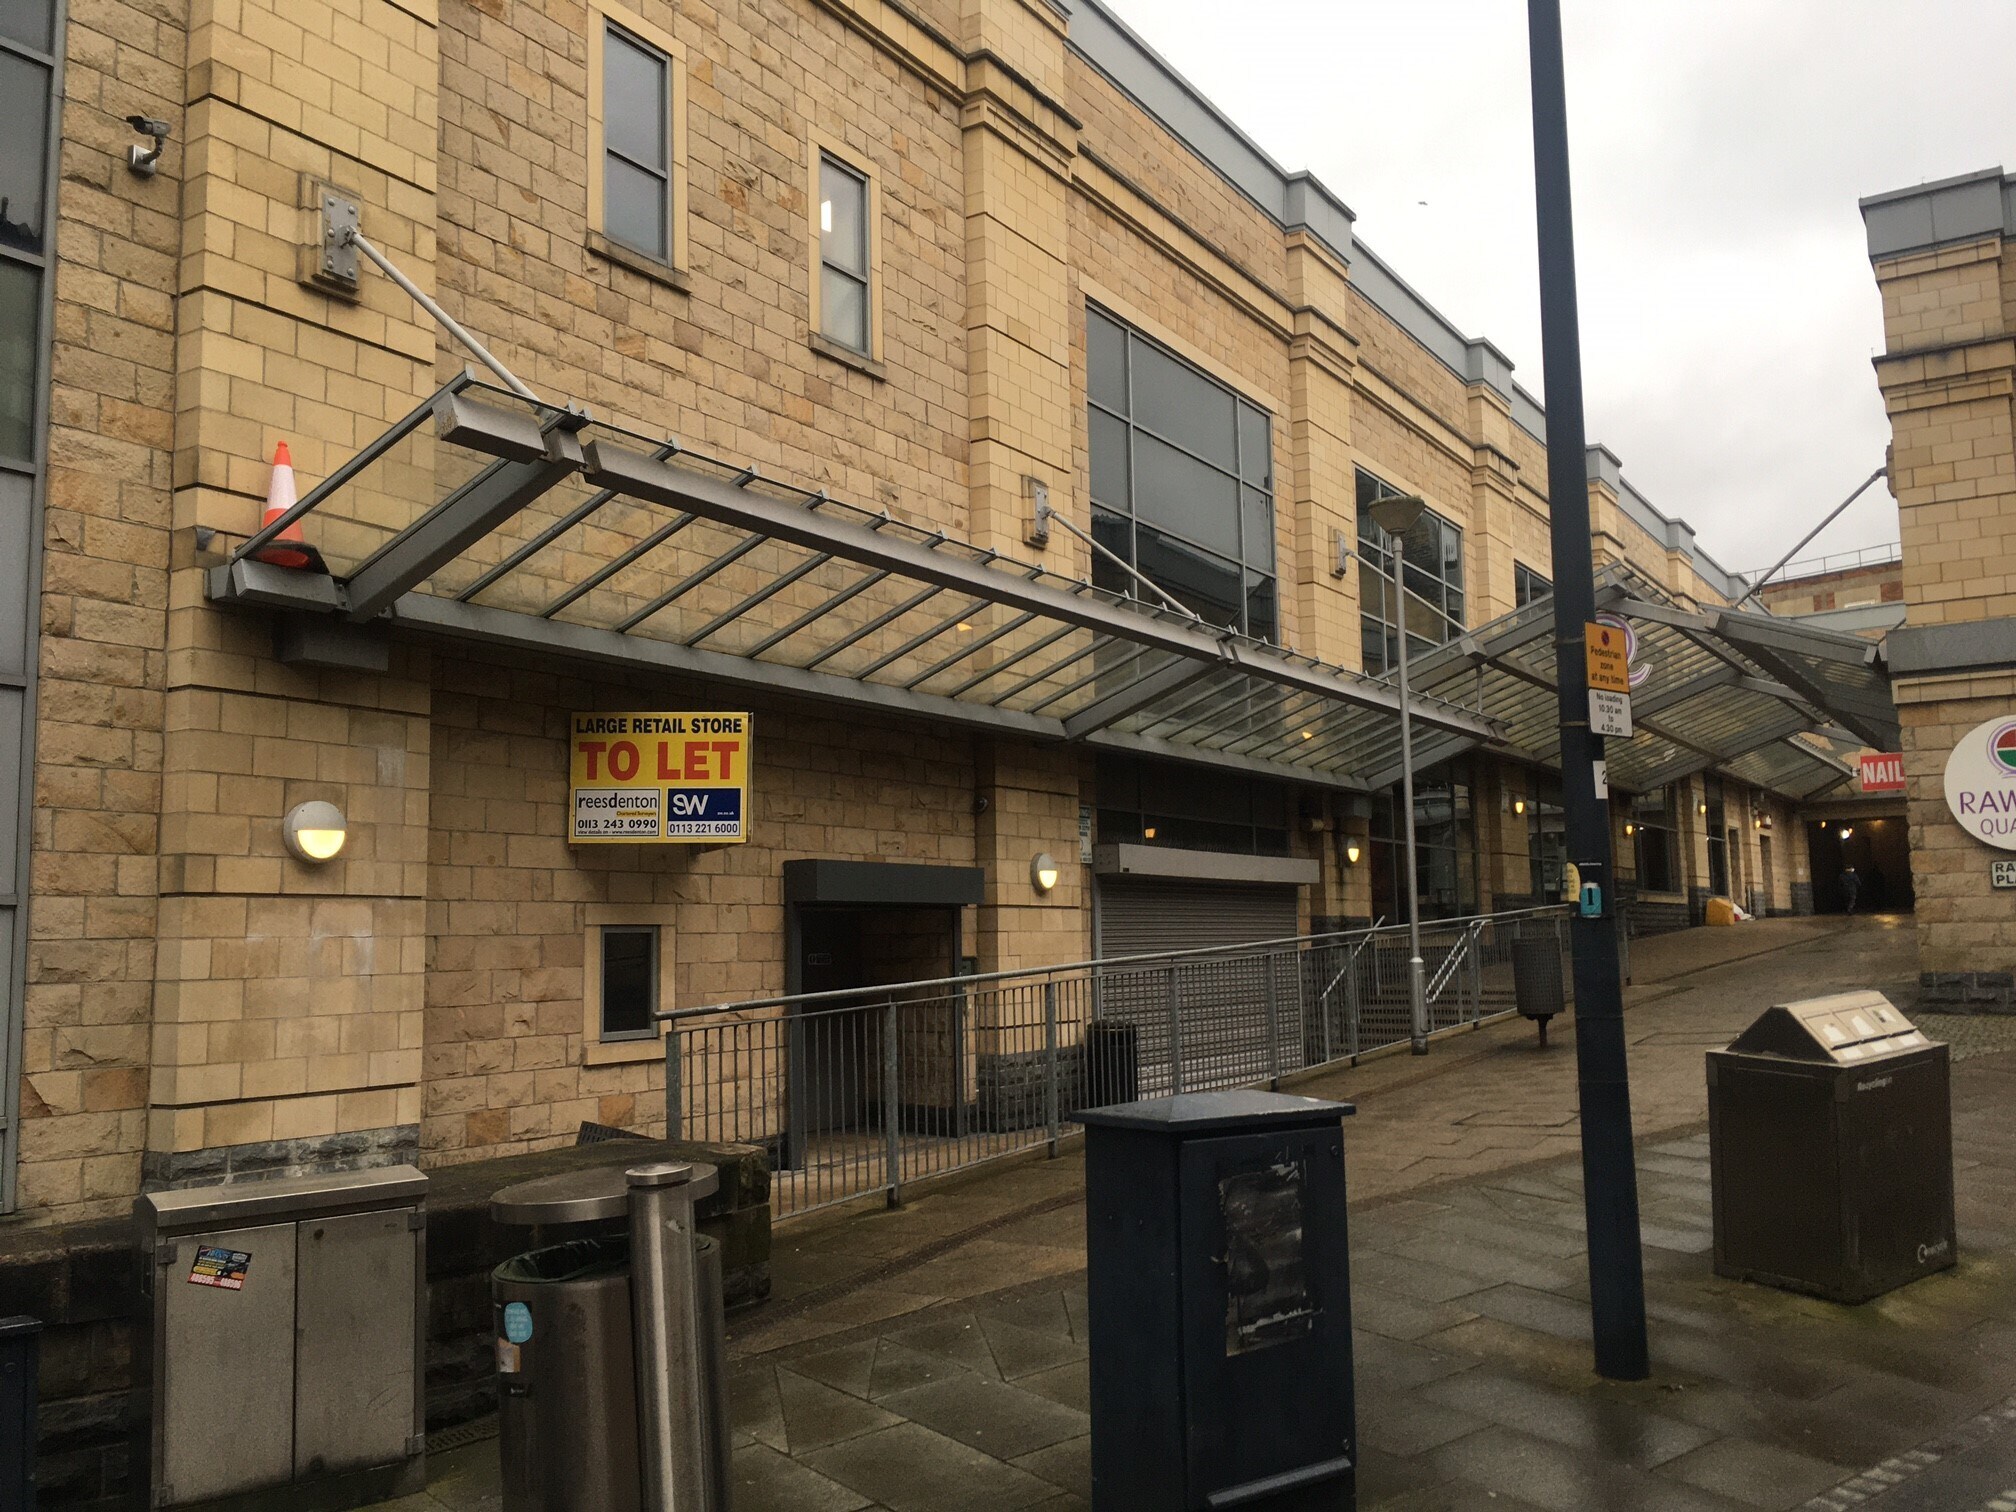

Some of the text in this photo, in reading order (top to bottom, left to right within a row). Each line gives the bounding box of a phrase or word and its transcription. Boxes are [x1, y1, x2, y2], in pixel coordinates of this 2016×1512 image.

[1590, 646, 1622, 660] Pedestrian
[1600, 662, 1614, 670] zone
[1599, 674, 1609, 684] any
[1610, 674, 1624, 685] time
[1596, 692, 1622, 704] No loading
[576, 718, 742, 733] LARGE RETAIL STORE
[578, 741, 739, 781] TO LET
[1863, 760, 1905, 784] NAIL
[578, 793, 657, 808] reesdenton
[672, 794, 708, 815] SW
[578, 820, 656, 828] 0113 243 0990
[670, 824, 737, 833] 0113 221 6000
[1997, 875, 2016, 884] PL
